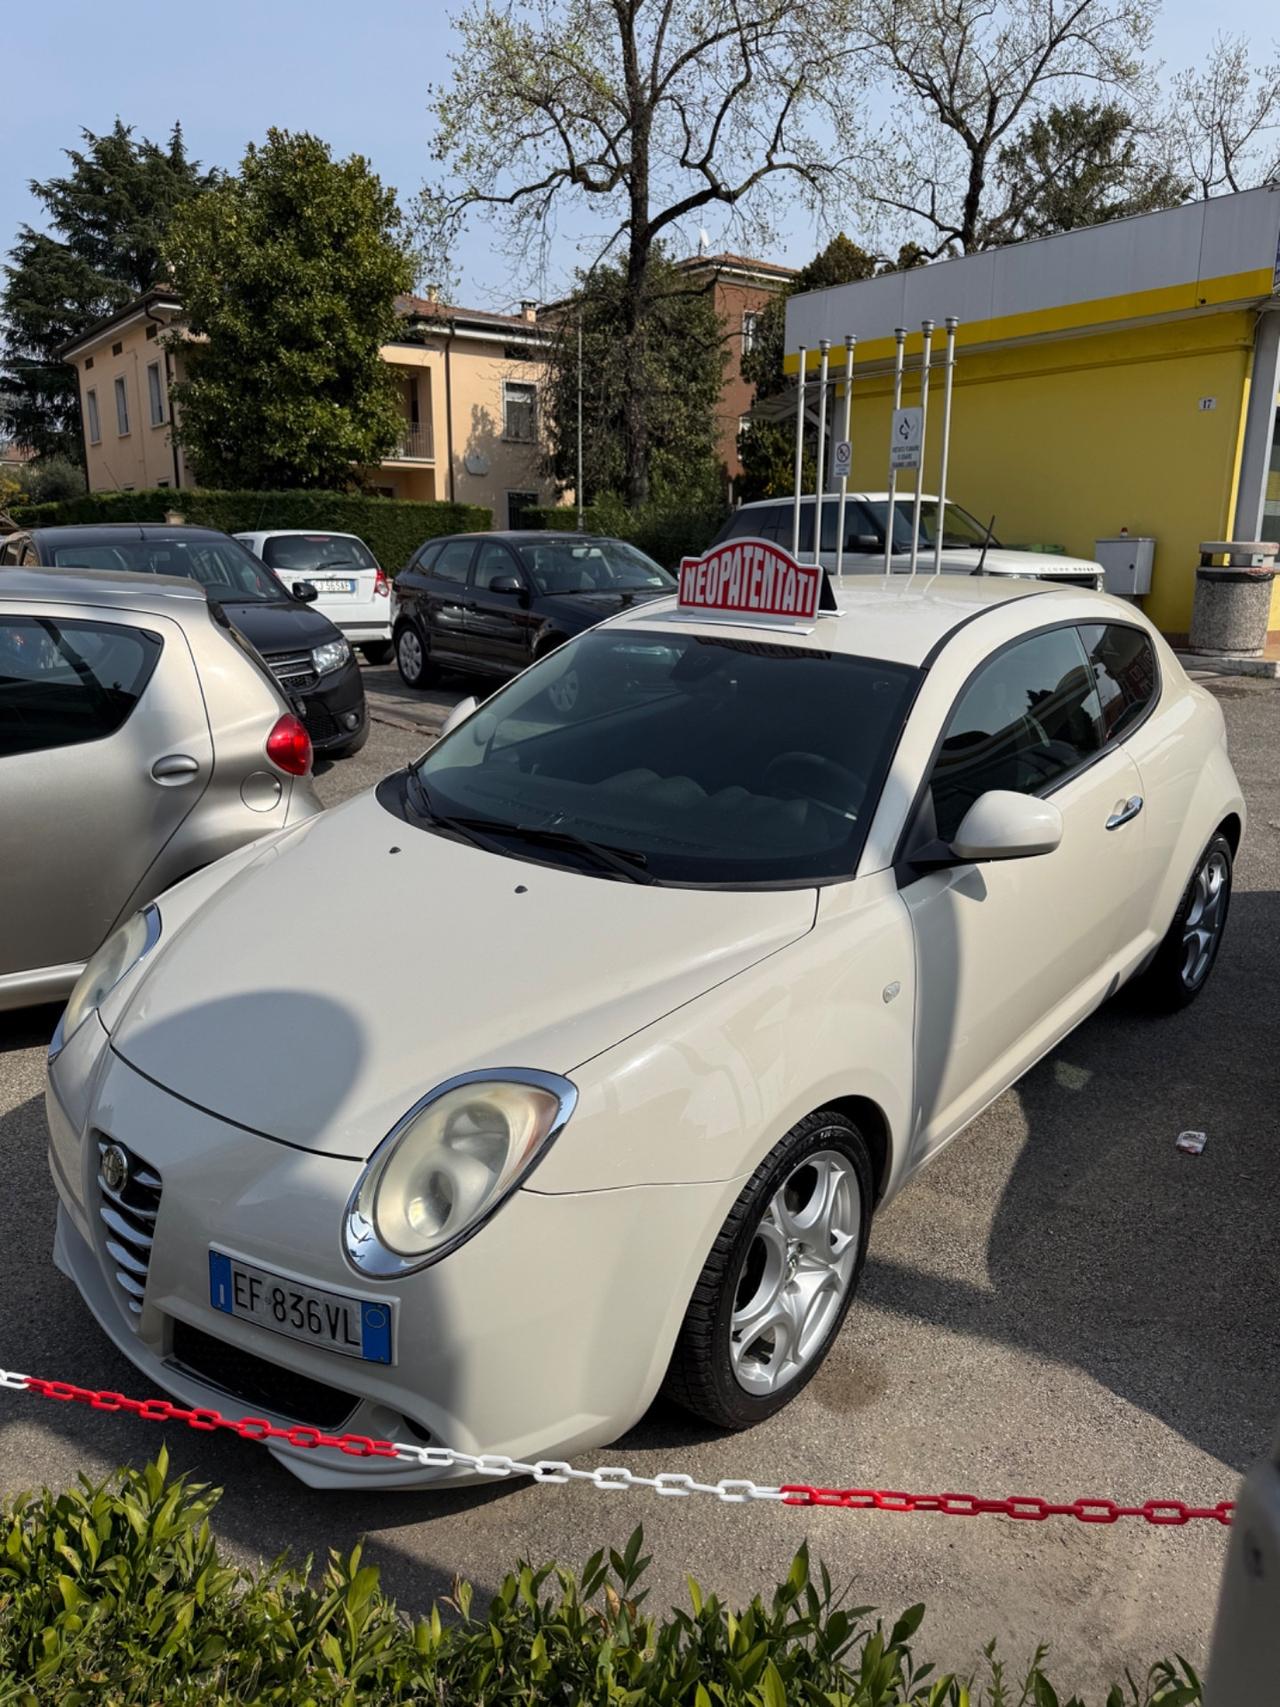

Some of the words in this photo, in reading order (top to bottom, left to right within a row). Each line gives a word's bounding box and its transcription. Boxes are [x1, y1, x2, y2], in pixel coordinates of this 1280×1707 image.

[1203, 399, 1213, 409] 17
[683, 545, 816, 614] NEOPATENTATI
[233, 1270, 263, 1311] EF
[272, 1287, 361, 1346] 836VL
